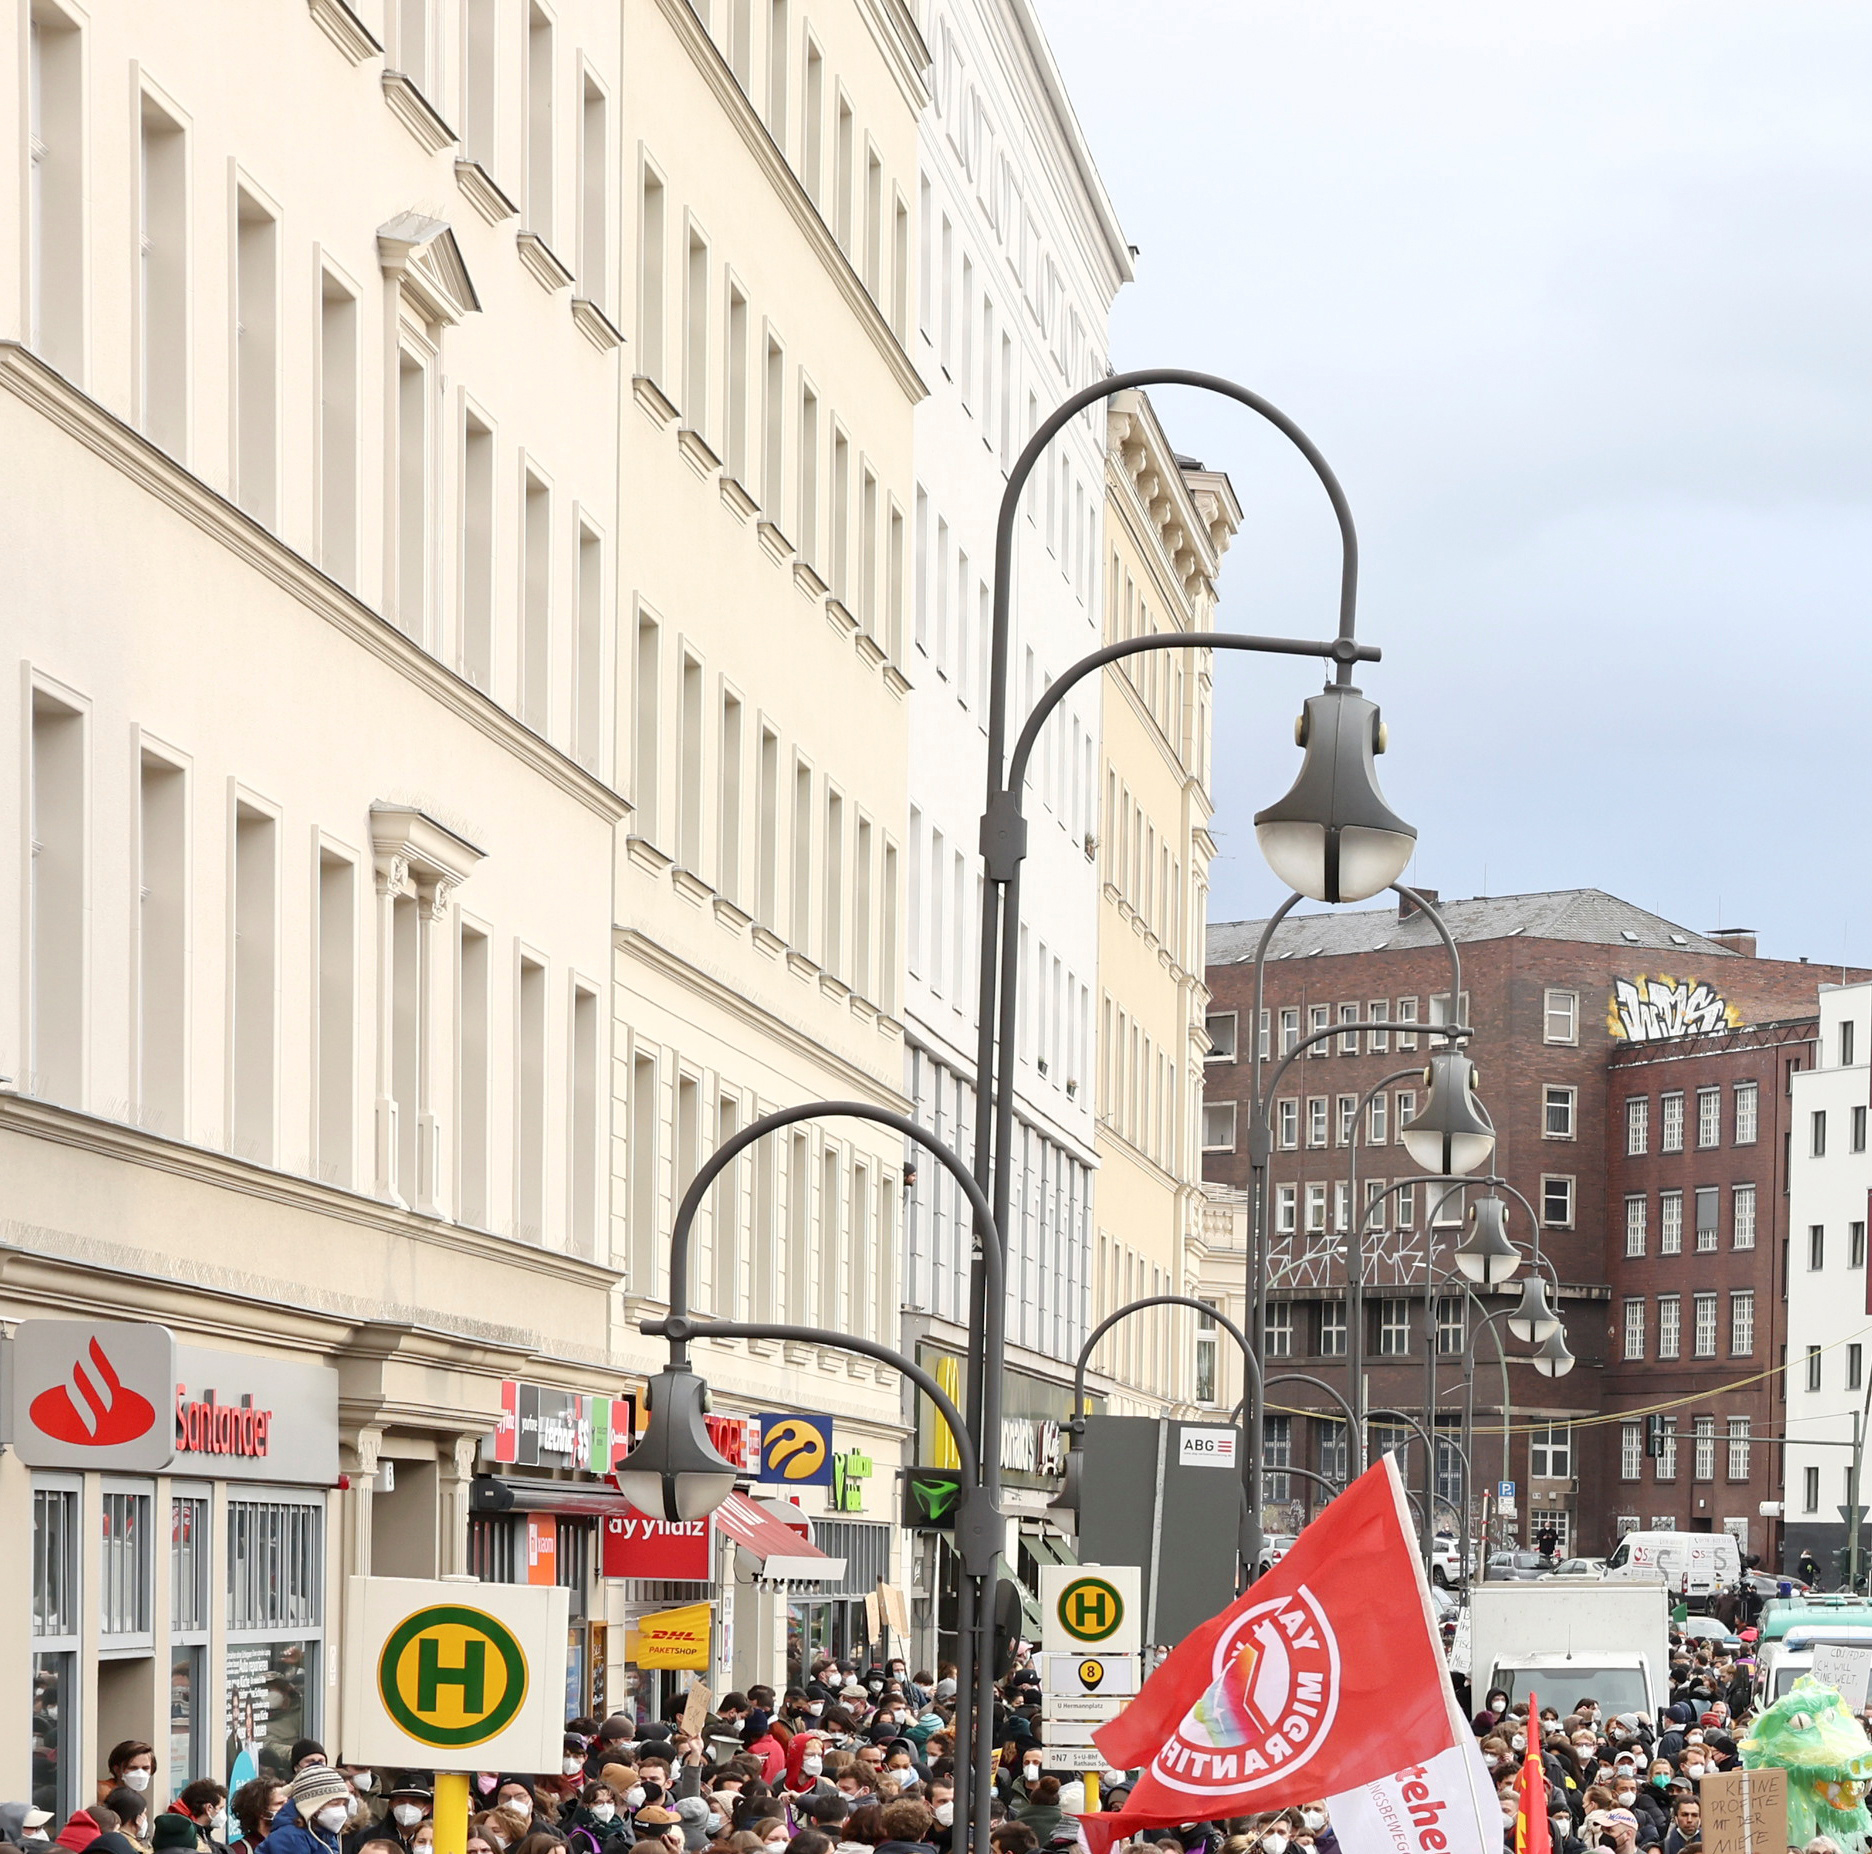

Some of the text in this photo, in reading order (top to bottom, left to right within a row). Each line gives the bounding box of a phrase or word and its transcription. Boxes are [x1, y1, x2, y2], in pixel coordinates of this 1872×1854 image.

[175, 1383, 273, 1457] Santander
[704, 1416, 747, 1468] TORE
[999, 1418, 1034, 1472] onald's
[1184, 1439, 1214, 1452] ABG
[1075, 1592, 1106, 1627] H
[650, 1629, 697, 1641] DHL
[649, 1646, 698, 1656] PAKETSHOP
[418, 1638, 486, 1713] H
[1087, 1666, 1096, 1678] 8
[1062, 1702, 1104, 1711] Hermannplatz
[1725, 1775, 1780, 1799] KEINE
[1737, 1812, 1766, 1828] DER
